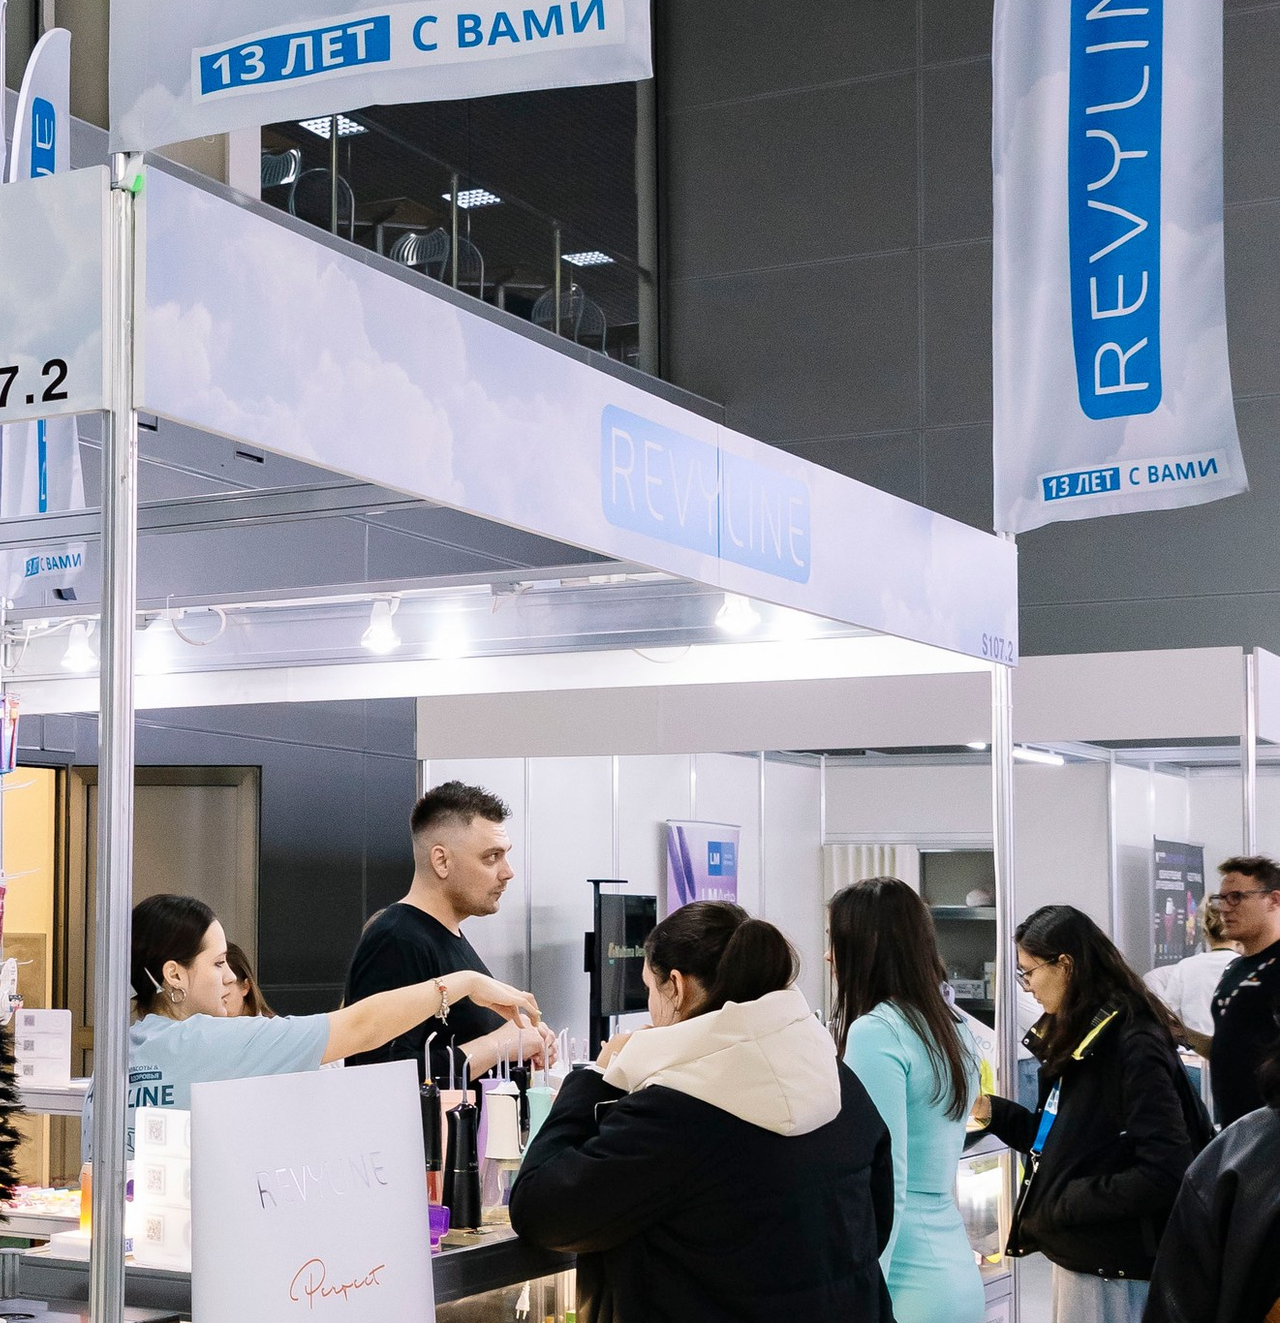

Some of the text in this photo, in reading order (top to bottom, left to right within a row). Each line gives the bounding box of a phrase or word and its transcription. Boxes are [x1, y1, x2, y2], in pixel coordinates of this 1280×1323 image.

[212, 44, 266, 86] 13
[280, 23, 375, 76] ЛЕТ
[610, 427, 806, 568] REVYLINE
[1048, 477, 1071, 499] 13
[1075, 472, 1115, 495] ЛЕТ
[1148, 457, 1218, 483] ВАМИ
[982, 633, 1013, 662] S107.2
[709, 852, 720, 865] LM
